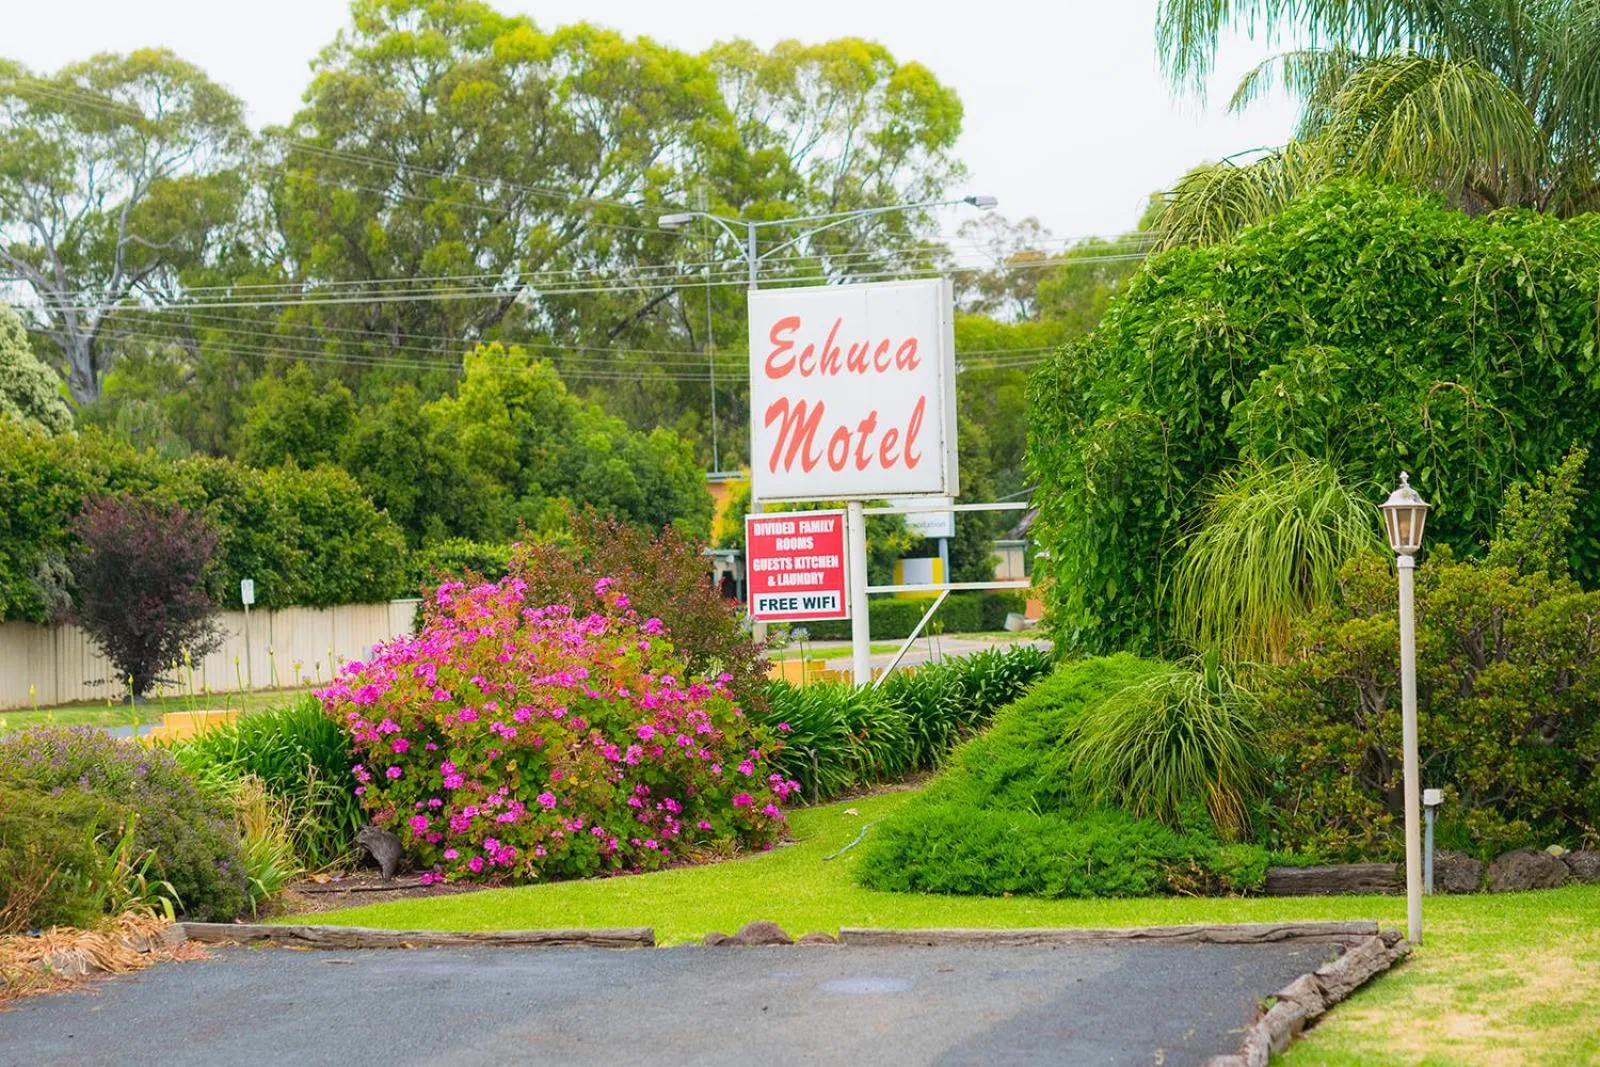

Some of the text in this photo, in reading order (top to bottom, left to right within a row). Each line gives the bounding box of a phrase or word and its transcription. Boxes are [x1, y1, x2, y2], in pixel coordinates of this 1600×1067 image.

[764, 315, 922, 380] Echuca
[764, 395, 926, 474] Motel
[754, 519, 835, 536] DIVIDED FAMILY
[776, 536, 814, 551] ROOMS
[753, 555, 839, 571] GUESTS KITCHEN
[767, 571, 825, 587] & LAUNDRY
[759, 596, 836, 611] FREE WIFI
